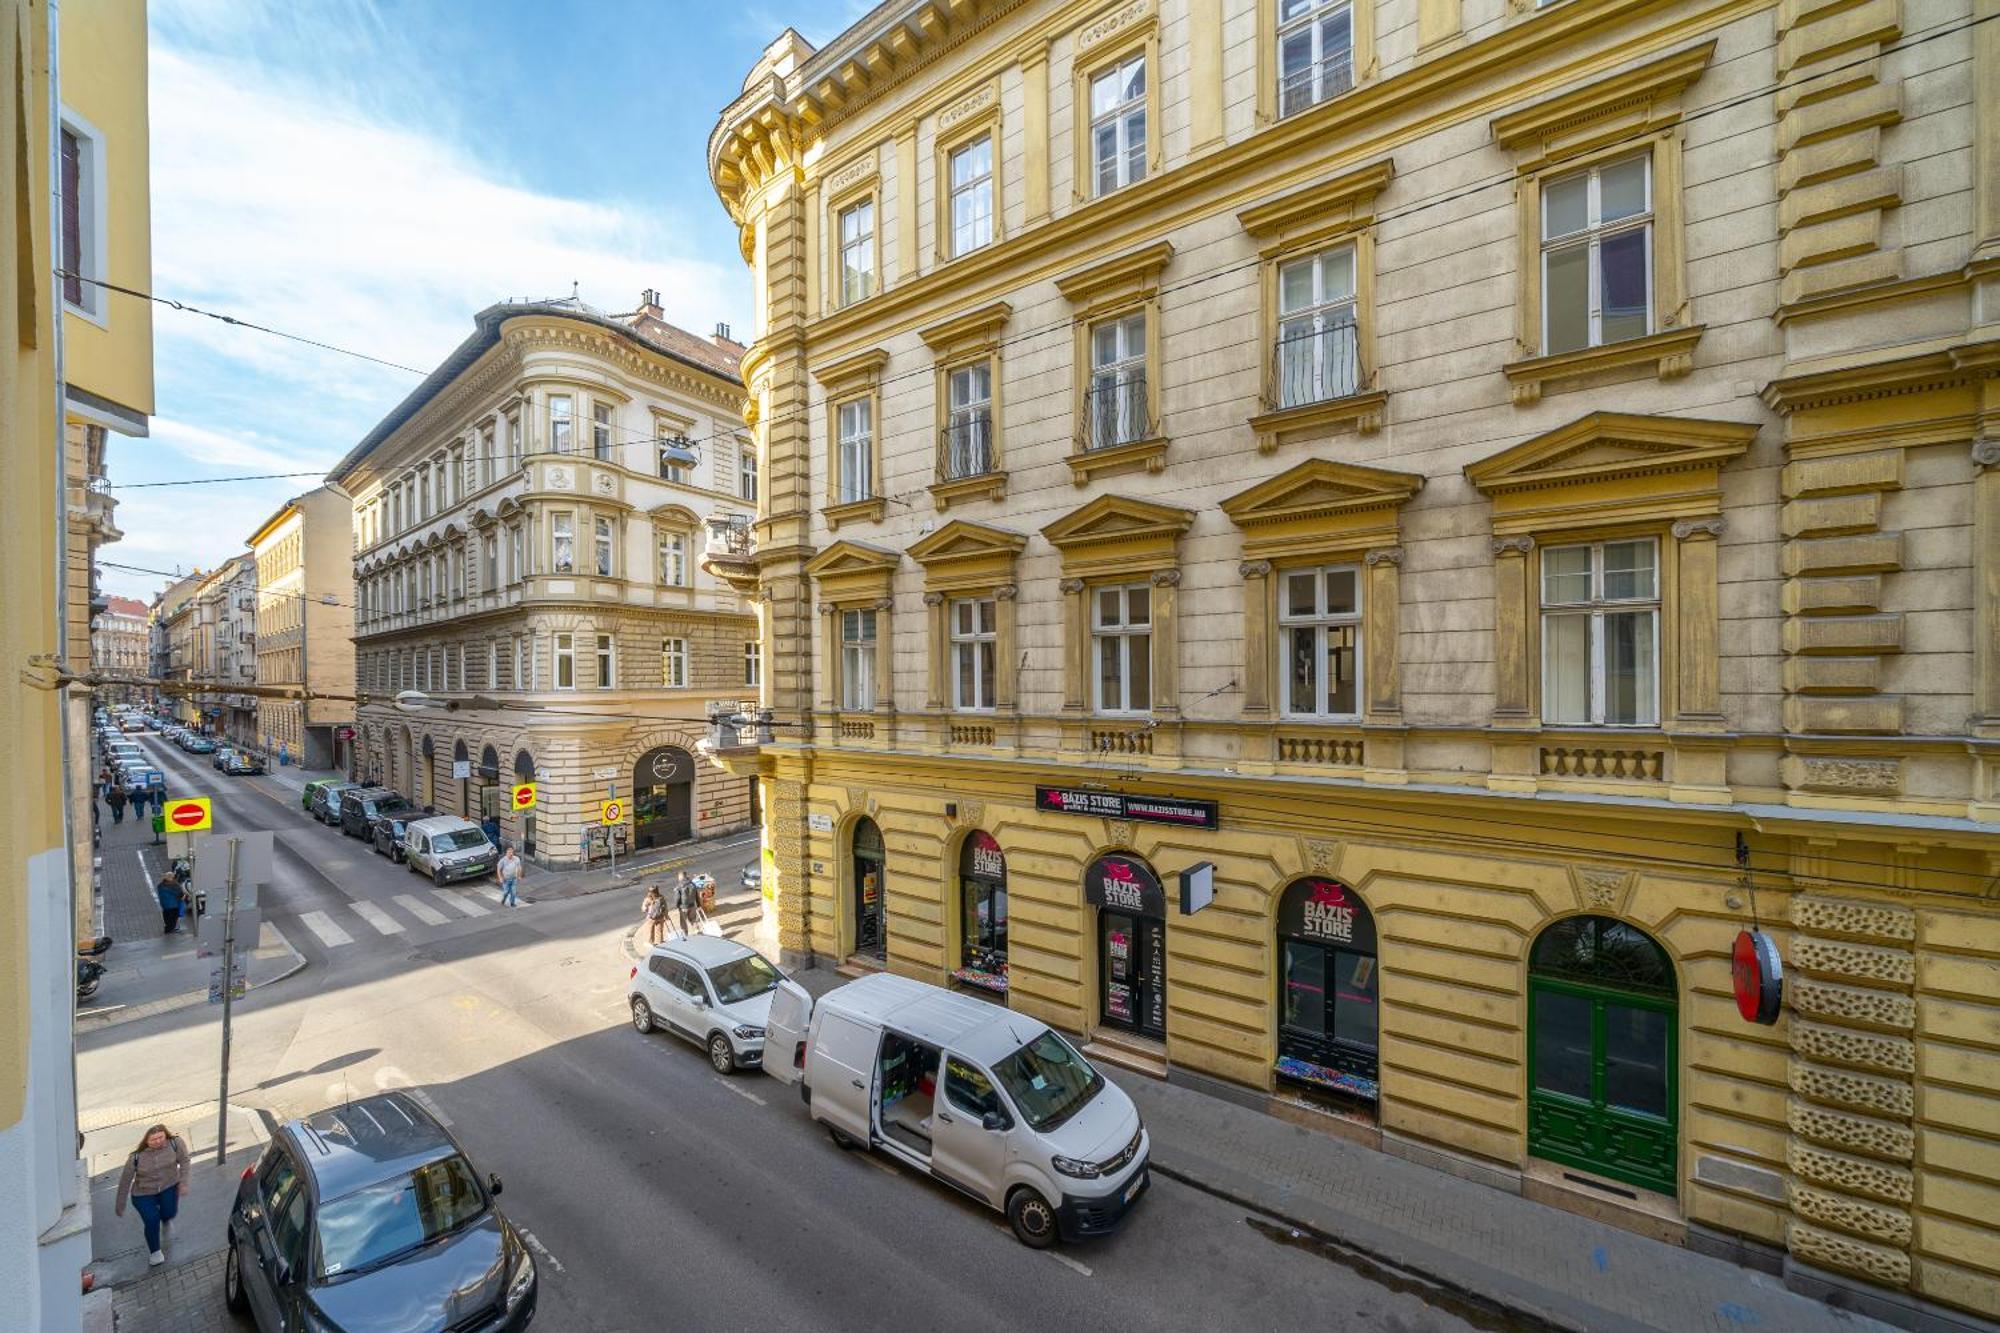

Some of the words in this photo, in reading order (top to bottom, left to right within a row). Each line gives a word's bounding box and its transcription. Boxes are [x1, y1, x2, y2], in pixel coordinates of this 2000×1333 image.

[1062, 791, 1089, 805] BÁZIS
[1090, 795, 1122, 809] STORE
[974, 847, 1002, 864] BÁZIS
[974, 860, 1002, 875] STORE
[1103, 877, 1141, 897] BÁZIS
[1105, 889, 1143, 908] STORE
[1304, 900, 1352, 924] BÁZIS
[1303, 916, 1352, 939] STORE
